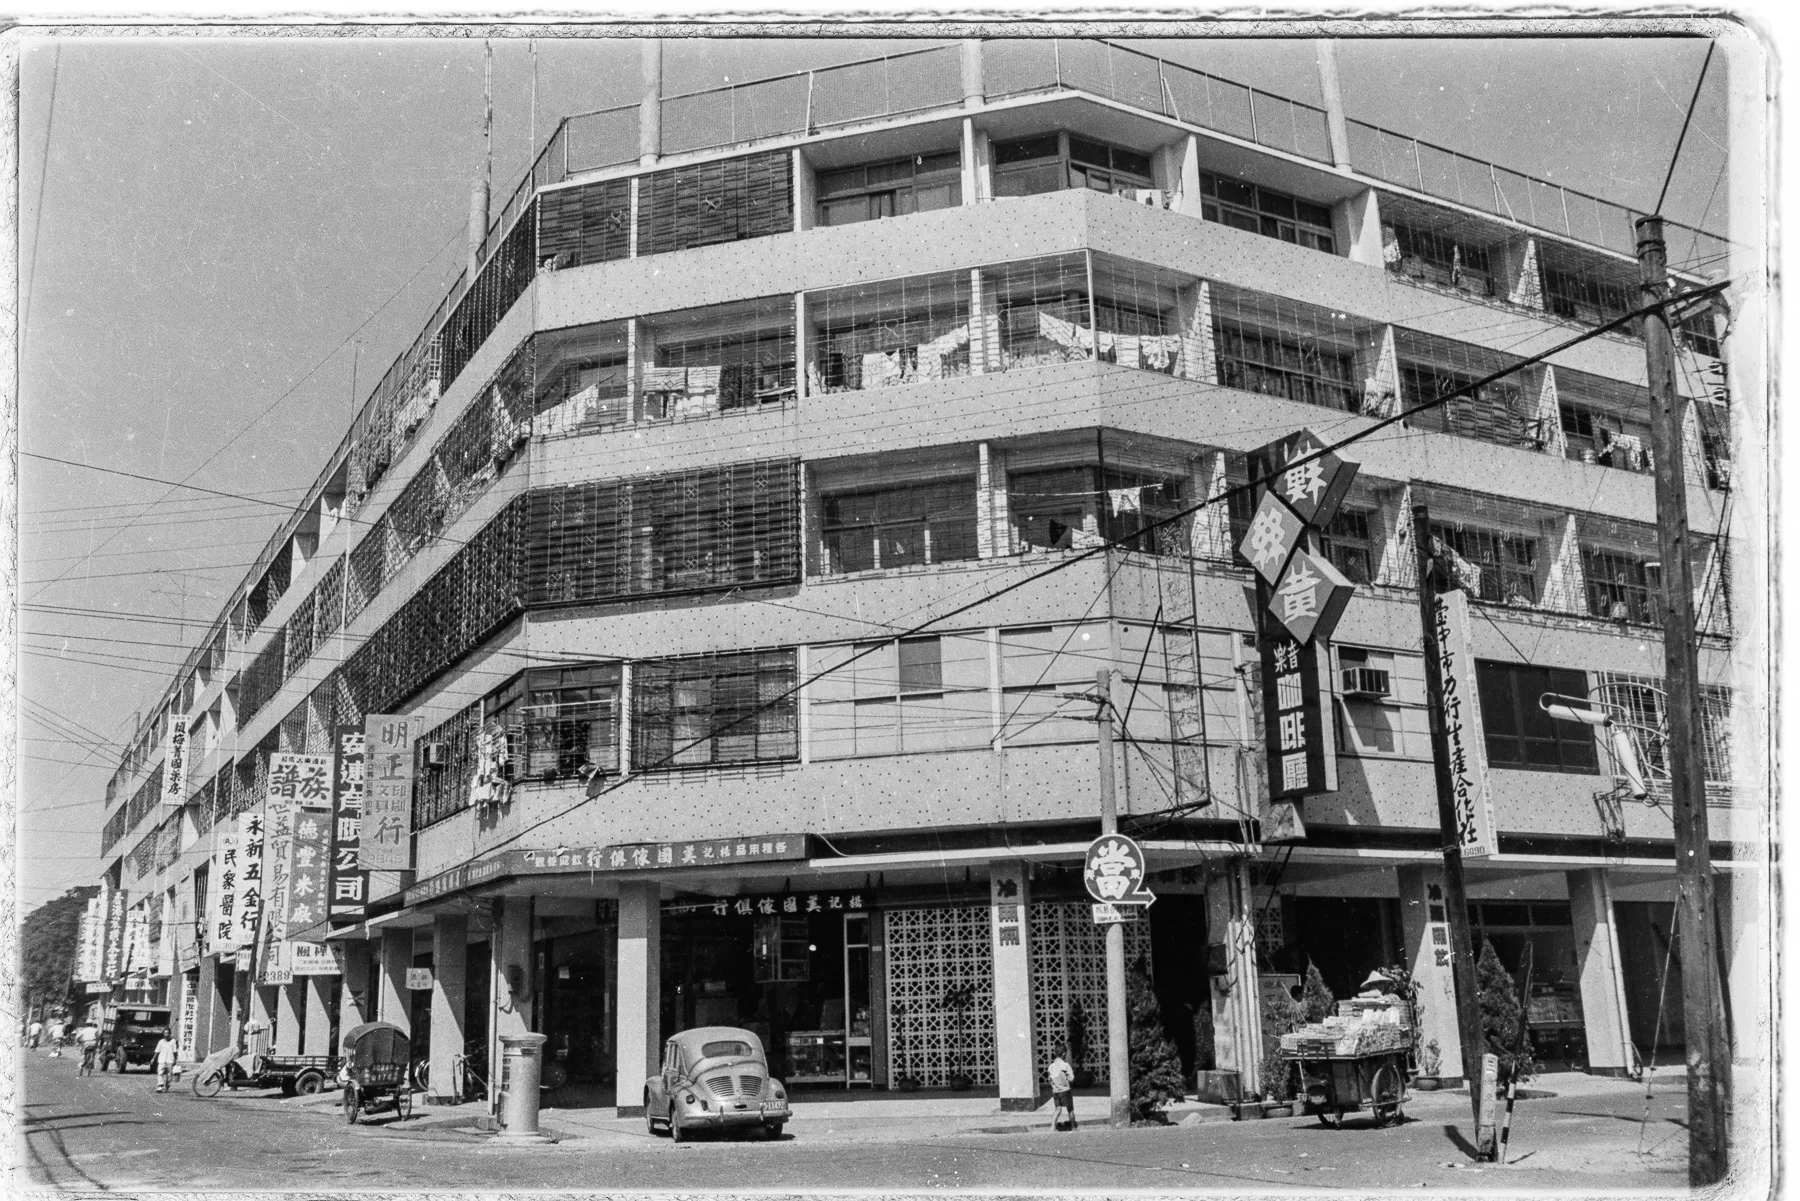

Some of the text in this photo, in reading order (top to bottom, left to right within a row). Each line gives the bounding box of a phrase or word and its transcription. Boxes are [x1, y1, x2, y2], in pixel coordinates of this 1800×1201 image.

[240, 815, 265, 932] 永新五金行
